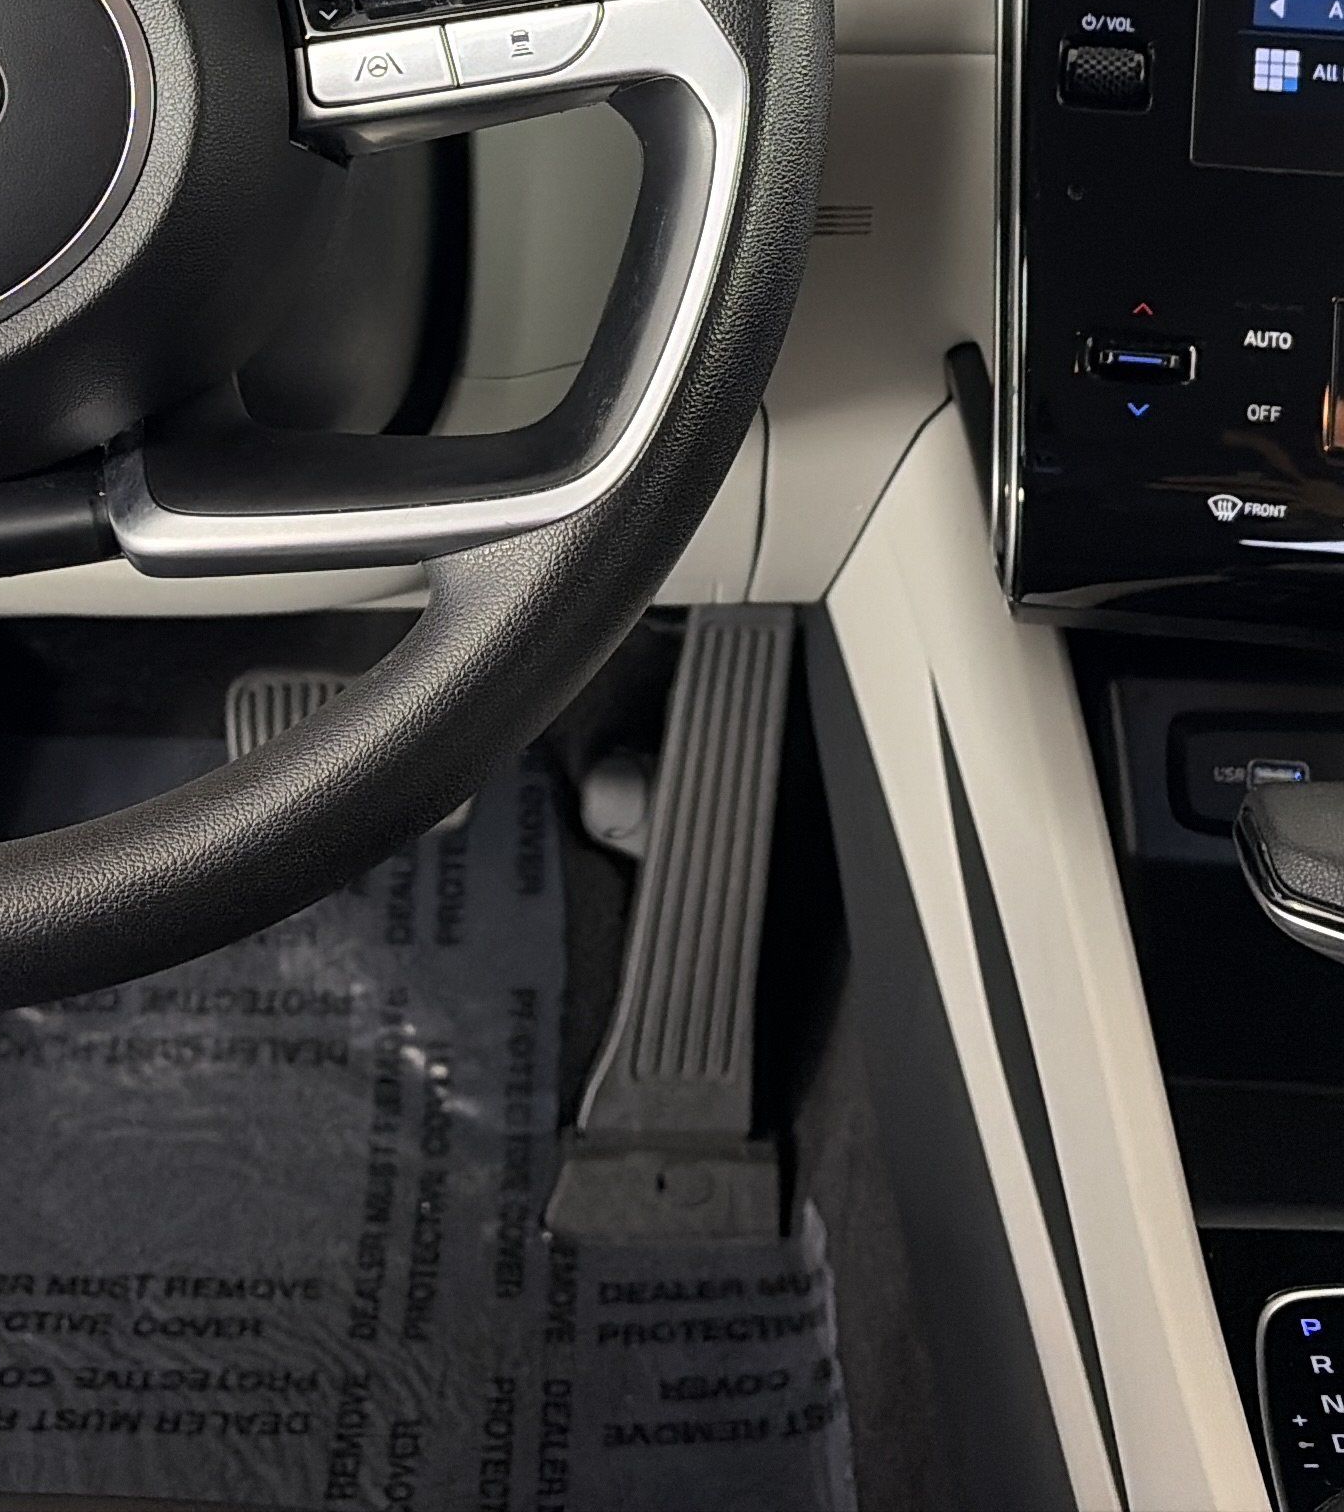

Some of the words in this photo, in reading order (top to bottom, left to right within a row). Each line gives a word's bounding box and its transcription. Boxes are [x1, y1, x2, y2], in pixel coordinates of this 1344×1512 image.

[1312, 63, 1338, 83] All
[1244, 329, 1293, 350] AUTO
[1247, 405, 1281, 423] OFF
[1244, 502, 1287, 518] FRONT
[44, 1273, 156, 1301] MUST
[163, 1276, 324, 1303] REMOVE
[598, 1278, 745, 1306] DEALER
[131, 1315, 264, 1341] COVER
[1300, 1318, 1322, 1337] P
[1310, 1355, 1334, 1375] R
[27, 1408, 145, 1436] MUST
[156, 1409, 312, 1436] DEALER
[538, 1378, 573, 1497] DEALER
